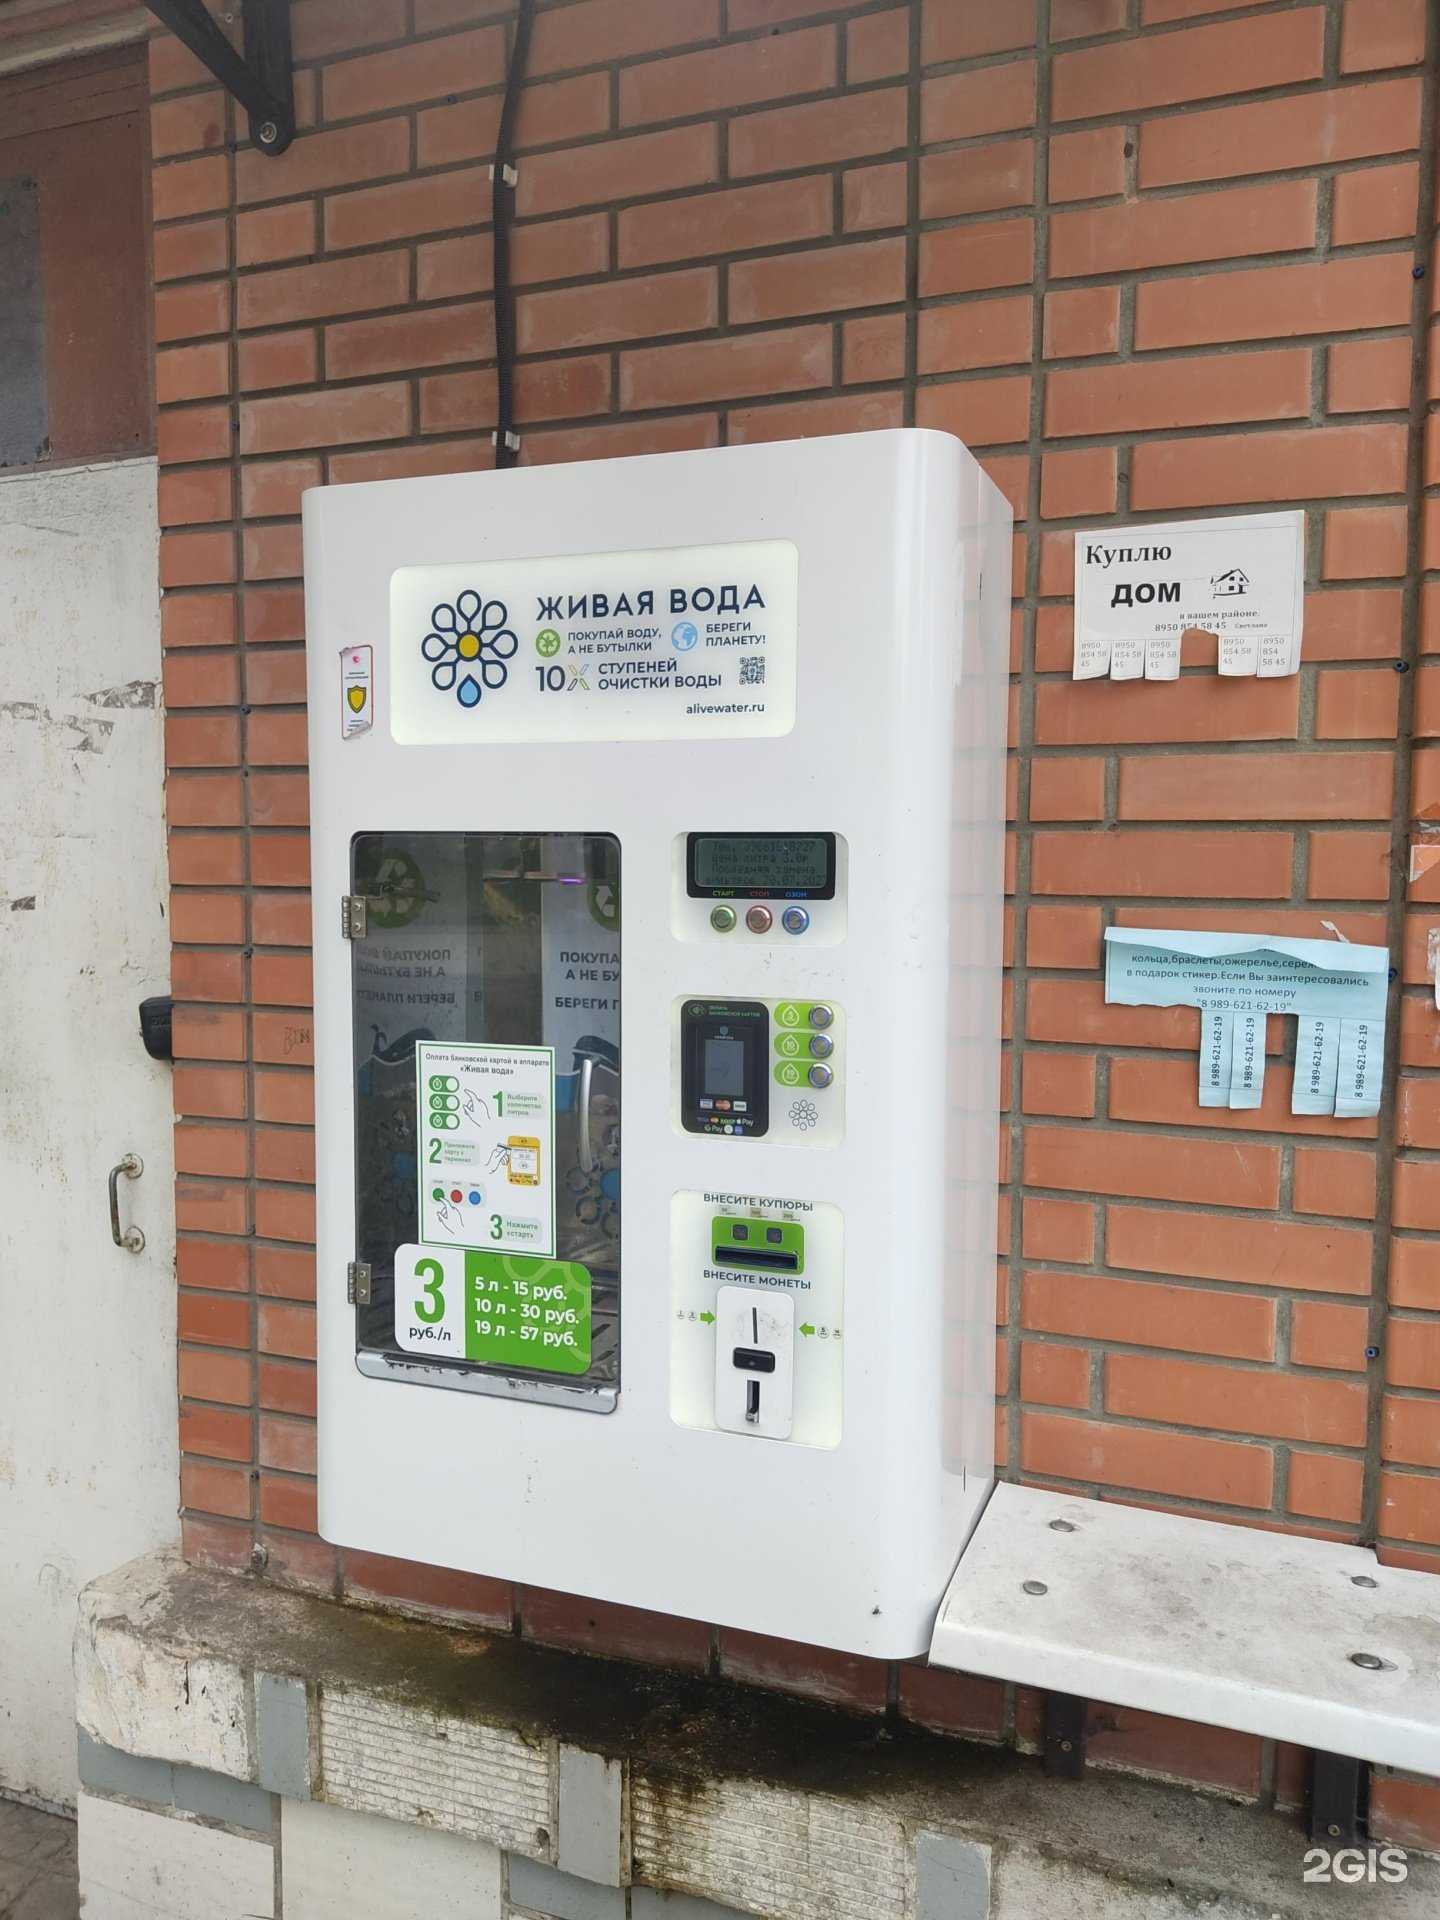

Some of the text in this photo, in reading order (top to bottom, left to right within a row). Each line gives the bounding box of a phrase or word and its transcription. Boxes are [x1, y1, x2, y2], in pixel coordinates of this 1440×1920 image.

[1087, 545, 1172, 569] Куплю
[536, 584, 766, 621] ЖИВАЯ ВОДА
[1187, 611, 1219, 620] вашем
[1221, 610, 1261, 619] районе.
[568, 628, 662, 641] ПОКУПАЙ ВОДУ,
[706, 622, 752, 633] БЕРЕГИ
[1155, 623, 1178, 632] 8950
[1215, 621, 1227, 629] 45
[568, 642, 653, 655] А НЕ БУТЫЛКИ
[706, 635, 767, 647] ПЛАНЕТУ!
[598, 656, 678, 675] СТУПЕНЕЙ
[598, 674, 722, 690] ОЧИСТКИ ВОДЫ
[686, 703, 765, 714] alivewater.ru
[566, 969, 576, 980] А
[580, 969, 598, 981] НЕ
[1135, 970, 1180, 980] подарок
[1249, 972, 1264, 981] Вы
[1267, 973, 1369, 987] заинтересовались
[1193, 985, 1297, 999] звоните по номеру
[555, 996, 608, 1010] БЕРЕГИ
[1211, 1016, 1223, 1080] 989-621-62-19
[1244, 1017, 1255, 1081] 989-621-62-19
[1311, 1021, 1324, 1087] 989-621-62-19
[1355, 1024, 1368, 1090] 989-621-62-19
[425, 1053, 449, 1061] Оплата
[451, 1053, 488, 1063] банковской
[490, 1056, 512, 1065] картой
[460, 1064, 514, 1076] «Живая вода»
[493, 1091, 503, 1117] 1
[429, 1138, 442, 1164] 2
[703, 1193, 814, 1212] ВНЕСИТЕ КУПЮРЫ
[490, 1214, 503, 1240] 3
[475, 1276, 485, 1290] 5
[488, 1281, 499, 1292] л
[512, 1280, 528, 1295] 15
[532, 1284, 568, 1301] руб.
[703, 1269, 811, 1290] ВНЕСИТЕ МОНЕТЫ
[414, 1257, 445, 1324] 3
[475, 1297, 491, 1313] 10
[495, 1303, 506, 1315] л
[520, 1303, 540, 1319] 30
[544, 1307, 580, 1325] руб.
[409, 1326, 451, 1341] руб./л
[475, 1319, 491, 1335] 19
[495, 1325, 506, 1337] л
[520, 1325, 539, 1341] 57
[543, 1330, 578, 1347] руб.
